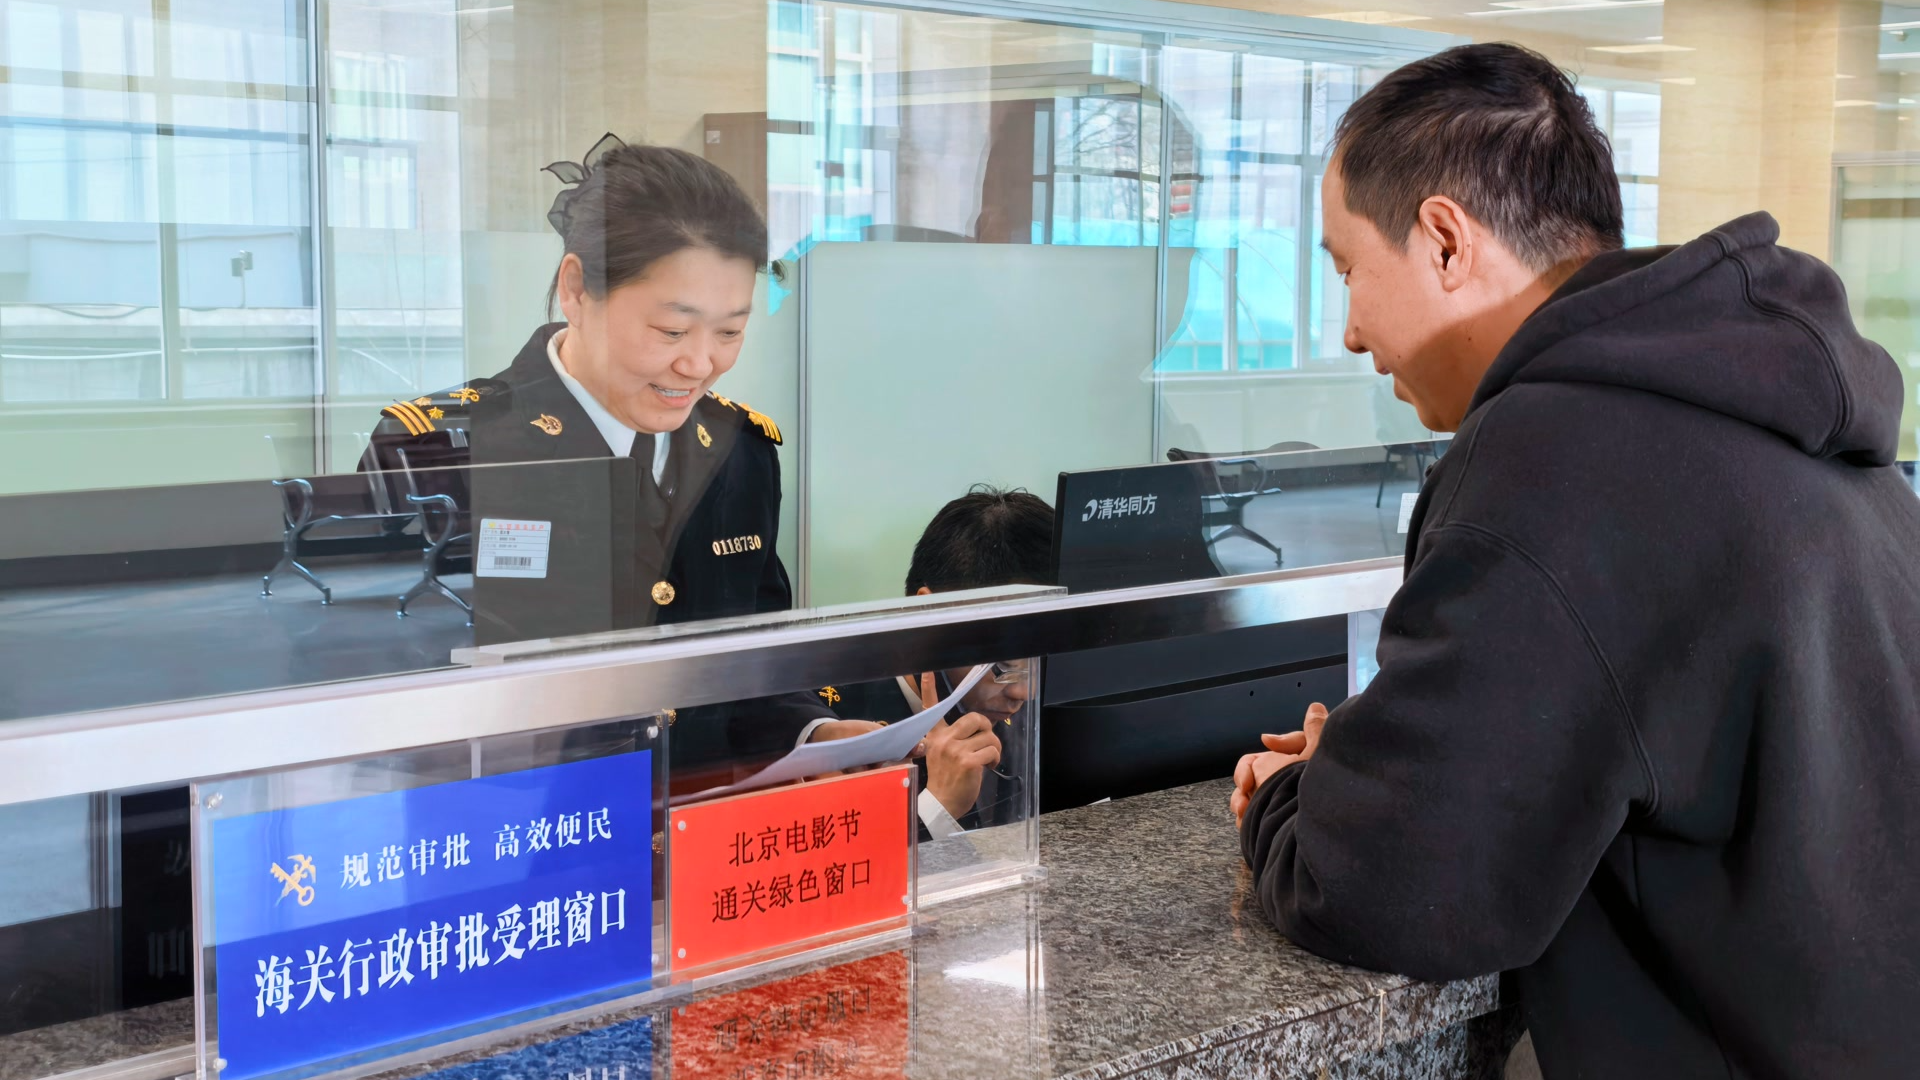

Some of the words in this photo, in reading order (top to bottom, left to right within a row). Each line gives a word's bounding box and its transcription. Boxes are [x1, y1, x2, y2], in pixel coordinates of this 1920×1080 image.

[1098, 494, 1157, 519] 清华同方
[712, 535, 761, 555] 0118730
[340, 833, 470, 889] 规范审批
[494, 807, 612, 860] 高效便民
[729, 809, 861, 867] 北京电影节
[712, 859, 870, 922] 通关绿色窗口
[255, 888, 626, 1017] 海关行政审批受理窗口
